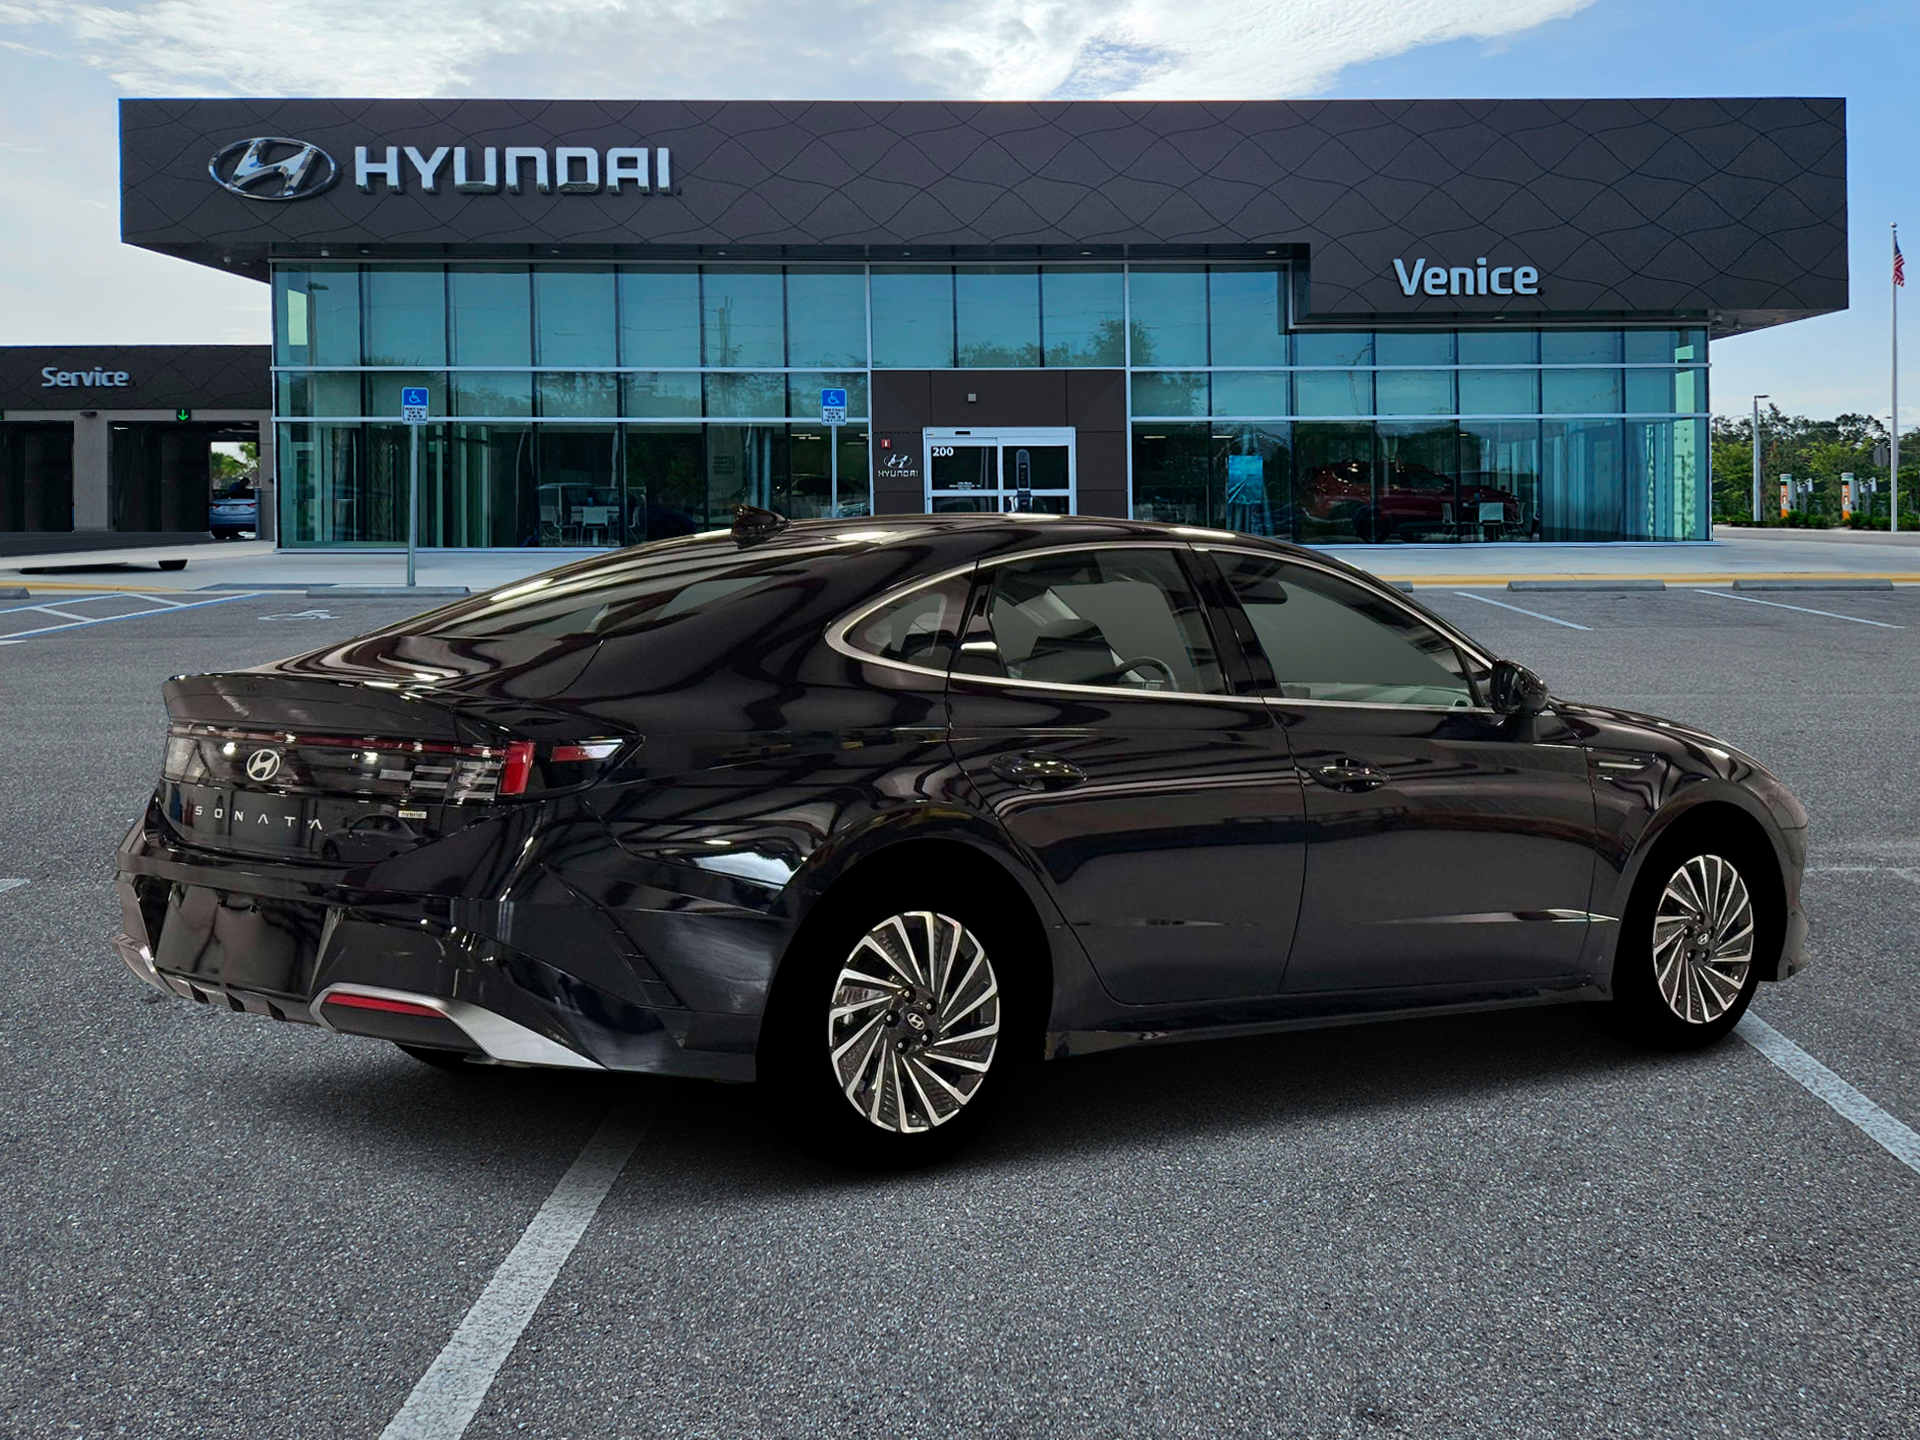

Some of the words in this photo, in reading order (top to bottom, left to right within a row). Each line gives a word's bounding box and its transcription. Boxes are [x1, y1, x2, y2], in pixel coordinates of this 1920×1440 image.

[354, 146, 671, 195] HYUNDAI
[1392, 257, 1539, 296] Venice
[41, 367, 130, 388] Service
[932, 446, 954, 457] 200
[877, 469, 919, 477] HYUNDAI
[194, 805, 324, 831] SONATA
